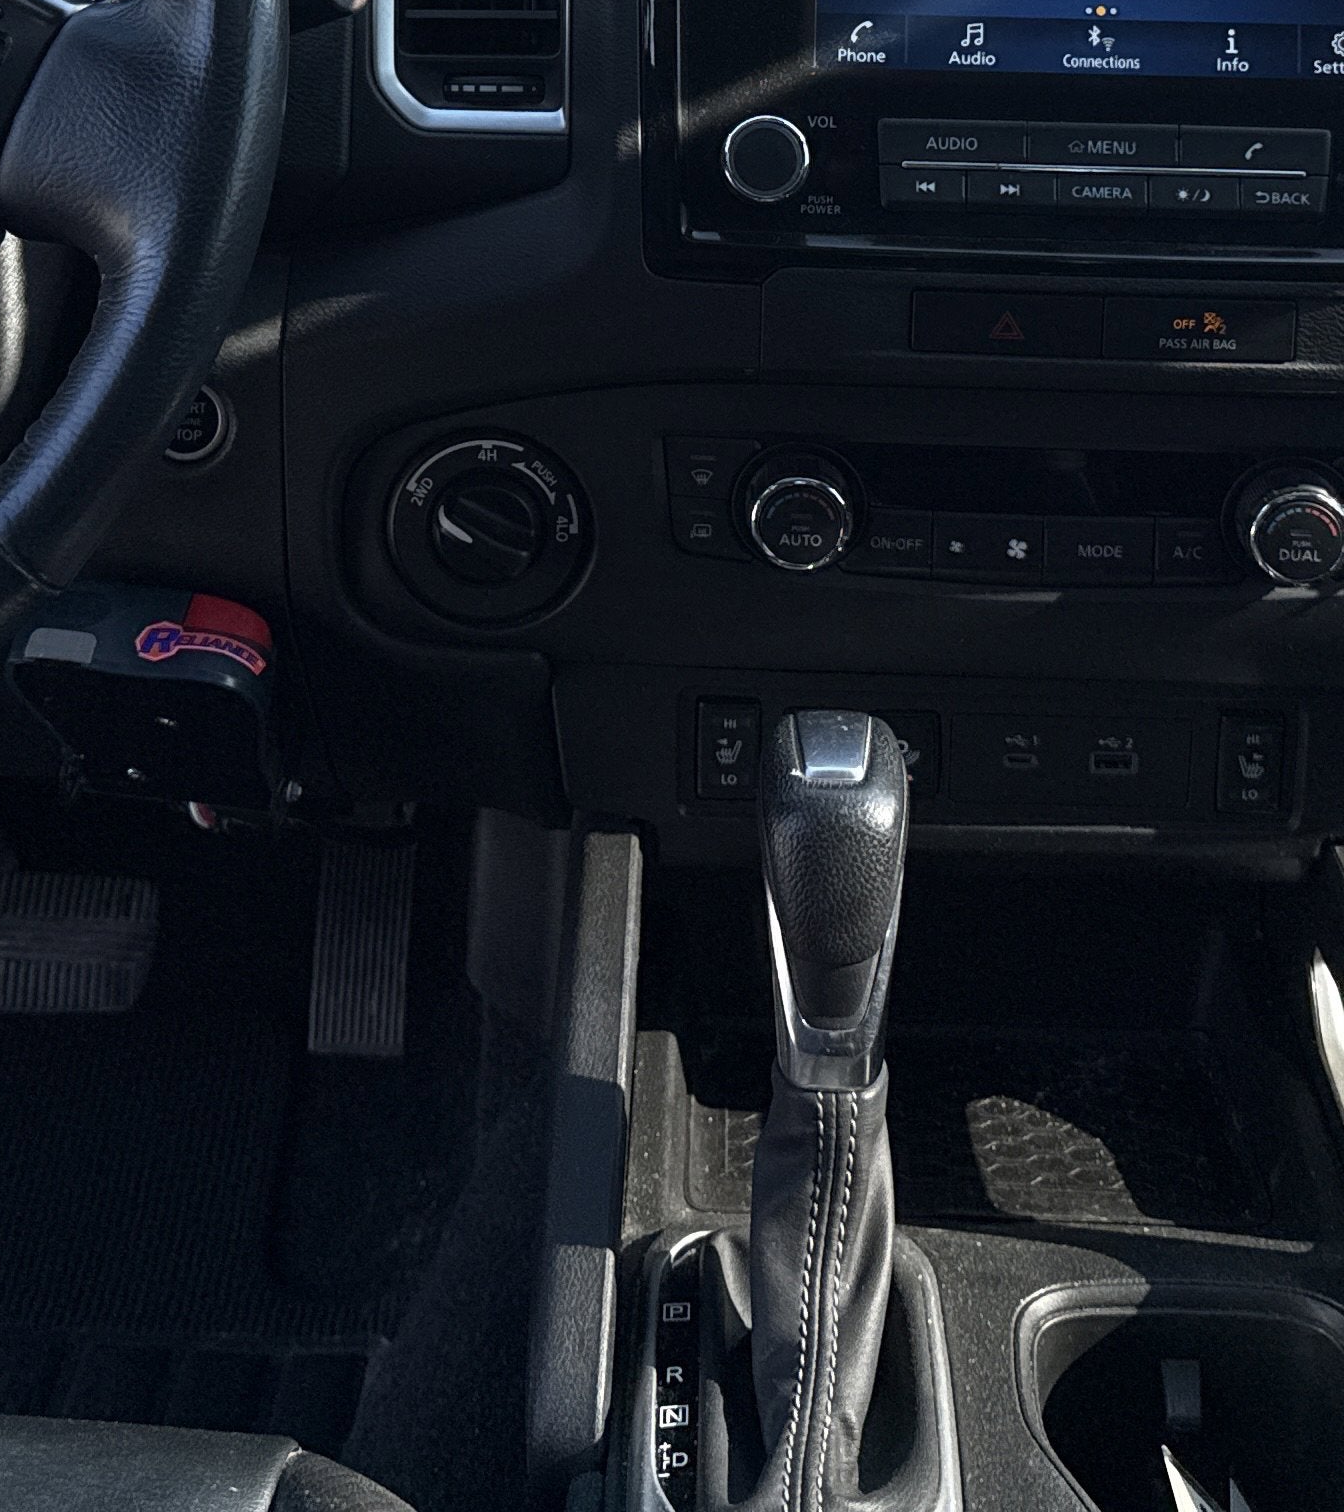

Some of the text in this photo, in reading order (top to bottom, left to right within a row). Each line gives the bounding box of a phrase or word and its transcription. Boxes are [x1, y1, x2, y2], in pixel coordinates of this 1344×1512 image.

[837, 47, 887, 65] Phone
[948, 50, 997, 67] Audio
[1062, 53, 1141, 70] Connections
[1215, 56, 1250, 73] Info
[807, 115, 838, 129] VOL
[925, 136, 979, 152] AUDIO
[1087, 139, 1138, 156] MENU
[807, 195, 835, 205] PUSH
[1071, 185, 1133, 201] CAMERA
[1271, 191, 1311, 206] BACK
[800, 205, 841, 215] POWER
[1173, 319, 1196, 330] OFF
[1158, 338, 1237, 350] PASS AIR BAG
[176, 429, 203, 441] TOP
[477, 449, 498, 462] 4H
[531, 460, 558, 487] PUSH
[410, 475, 435, 507] 2WD
[779, 533, 822, 547] AUTO
[1077, 544, 1123, 558] MODE
[1173, 545, 1203, 560] A/C
[1278, 547, 1322, 563] DUAL
[721, 774, 736, 785] LO
[1241, 789, 1259, 800] LO
[667, 1367, 683, 1382] R
[673, 1452, 688, 1467] D
